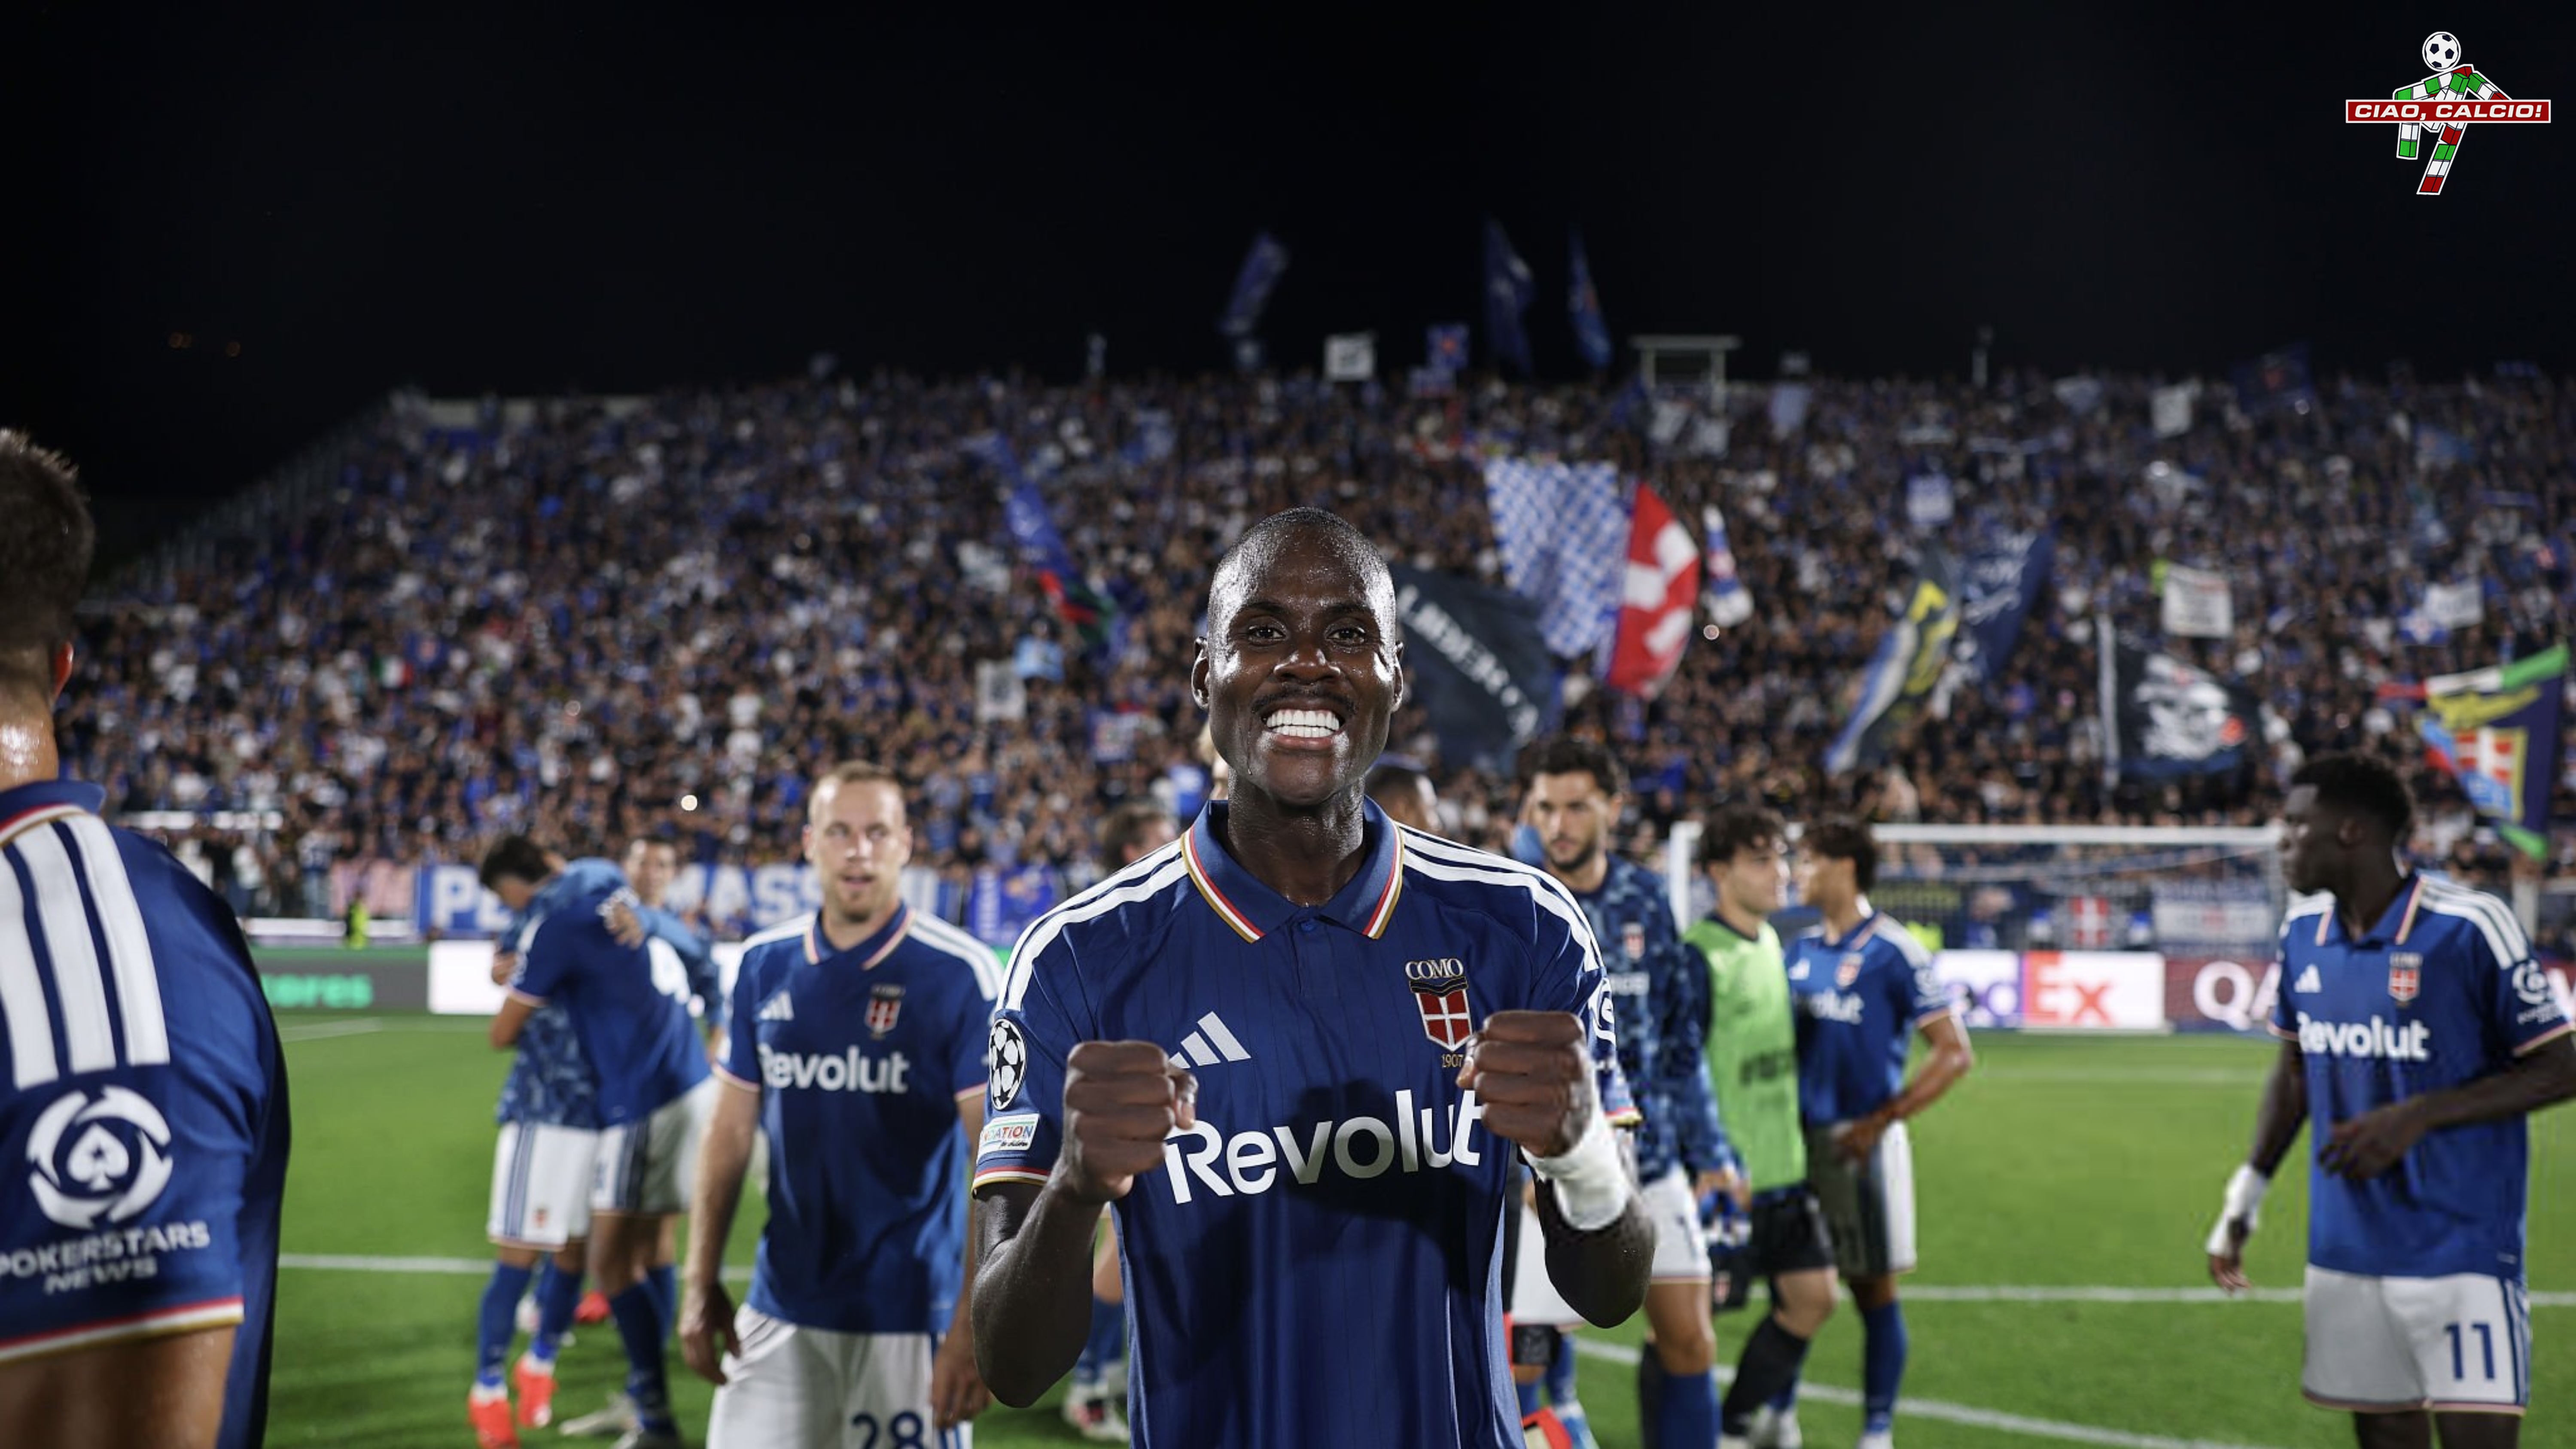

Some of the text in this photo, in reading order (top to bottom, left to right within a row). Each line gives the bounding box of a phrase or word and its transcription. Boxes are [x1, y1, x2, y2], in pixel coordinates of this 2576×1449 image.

[1405, 958, 1464, 980] COMO
[1441, 1053, 1464, 1068] 1907
[1163, 1089, 1483, 1205] Revolut
[44, 1256, 159, 1295] NEWS
[2444, 1320, 2496, 1382] 11
[851, 1409, 926, 1449] 28
